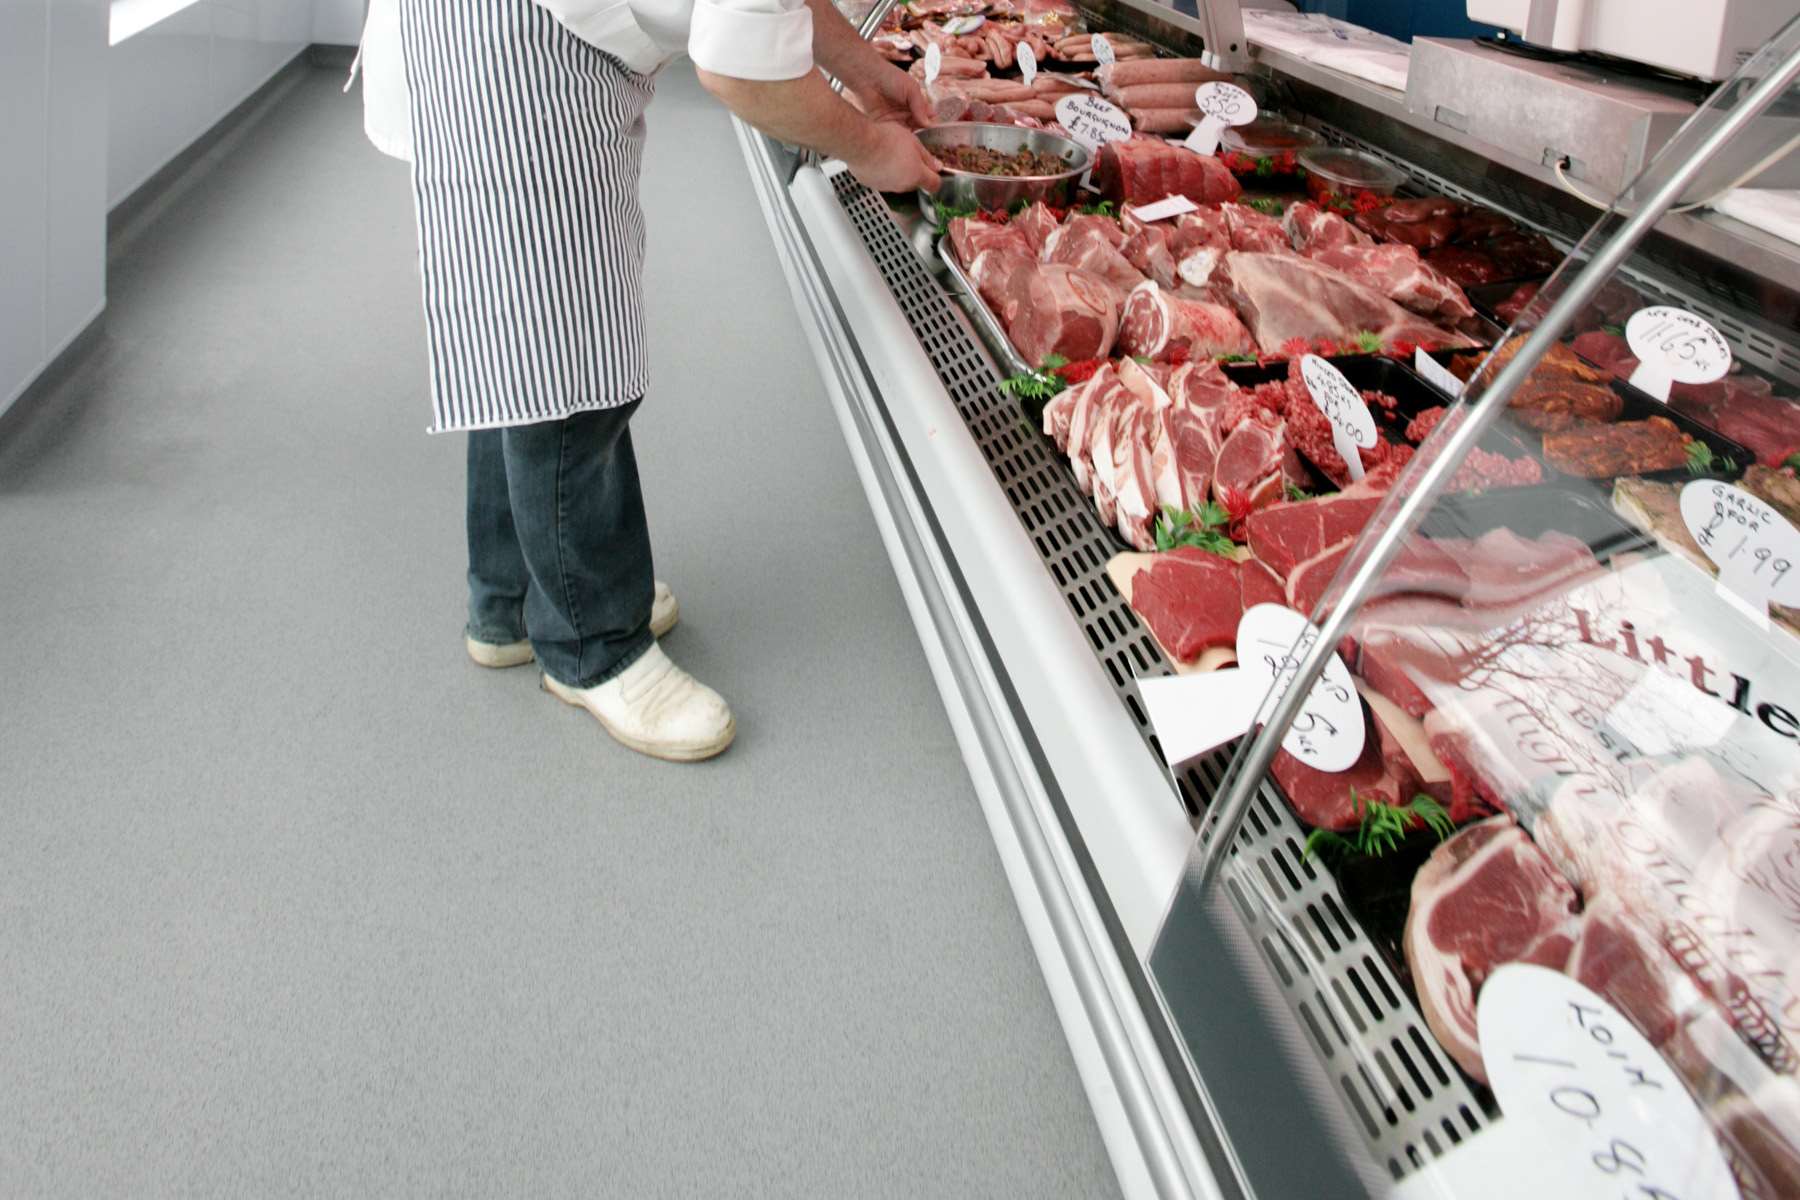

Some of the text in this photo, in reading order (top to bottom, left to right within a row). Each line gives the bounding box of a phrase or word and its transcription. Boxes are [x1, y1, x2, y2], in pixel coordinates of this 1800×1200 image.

[1711, 484, 1772, 525] GARLIC
[1569, 605, 1800, 738] Little
[1567, 998, 1663, 1092] LOIN
